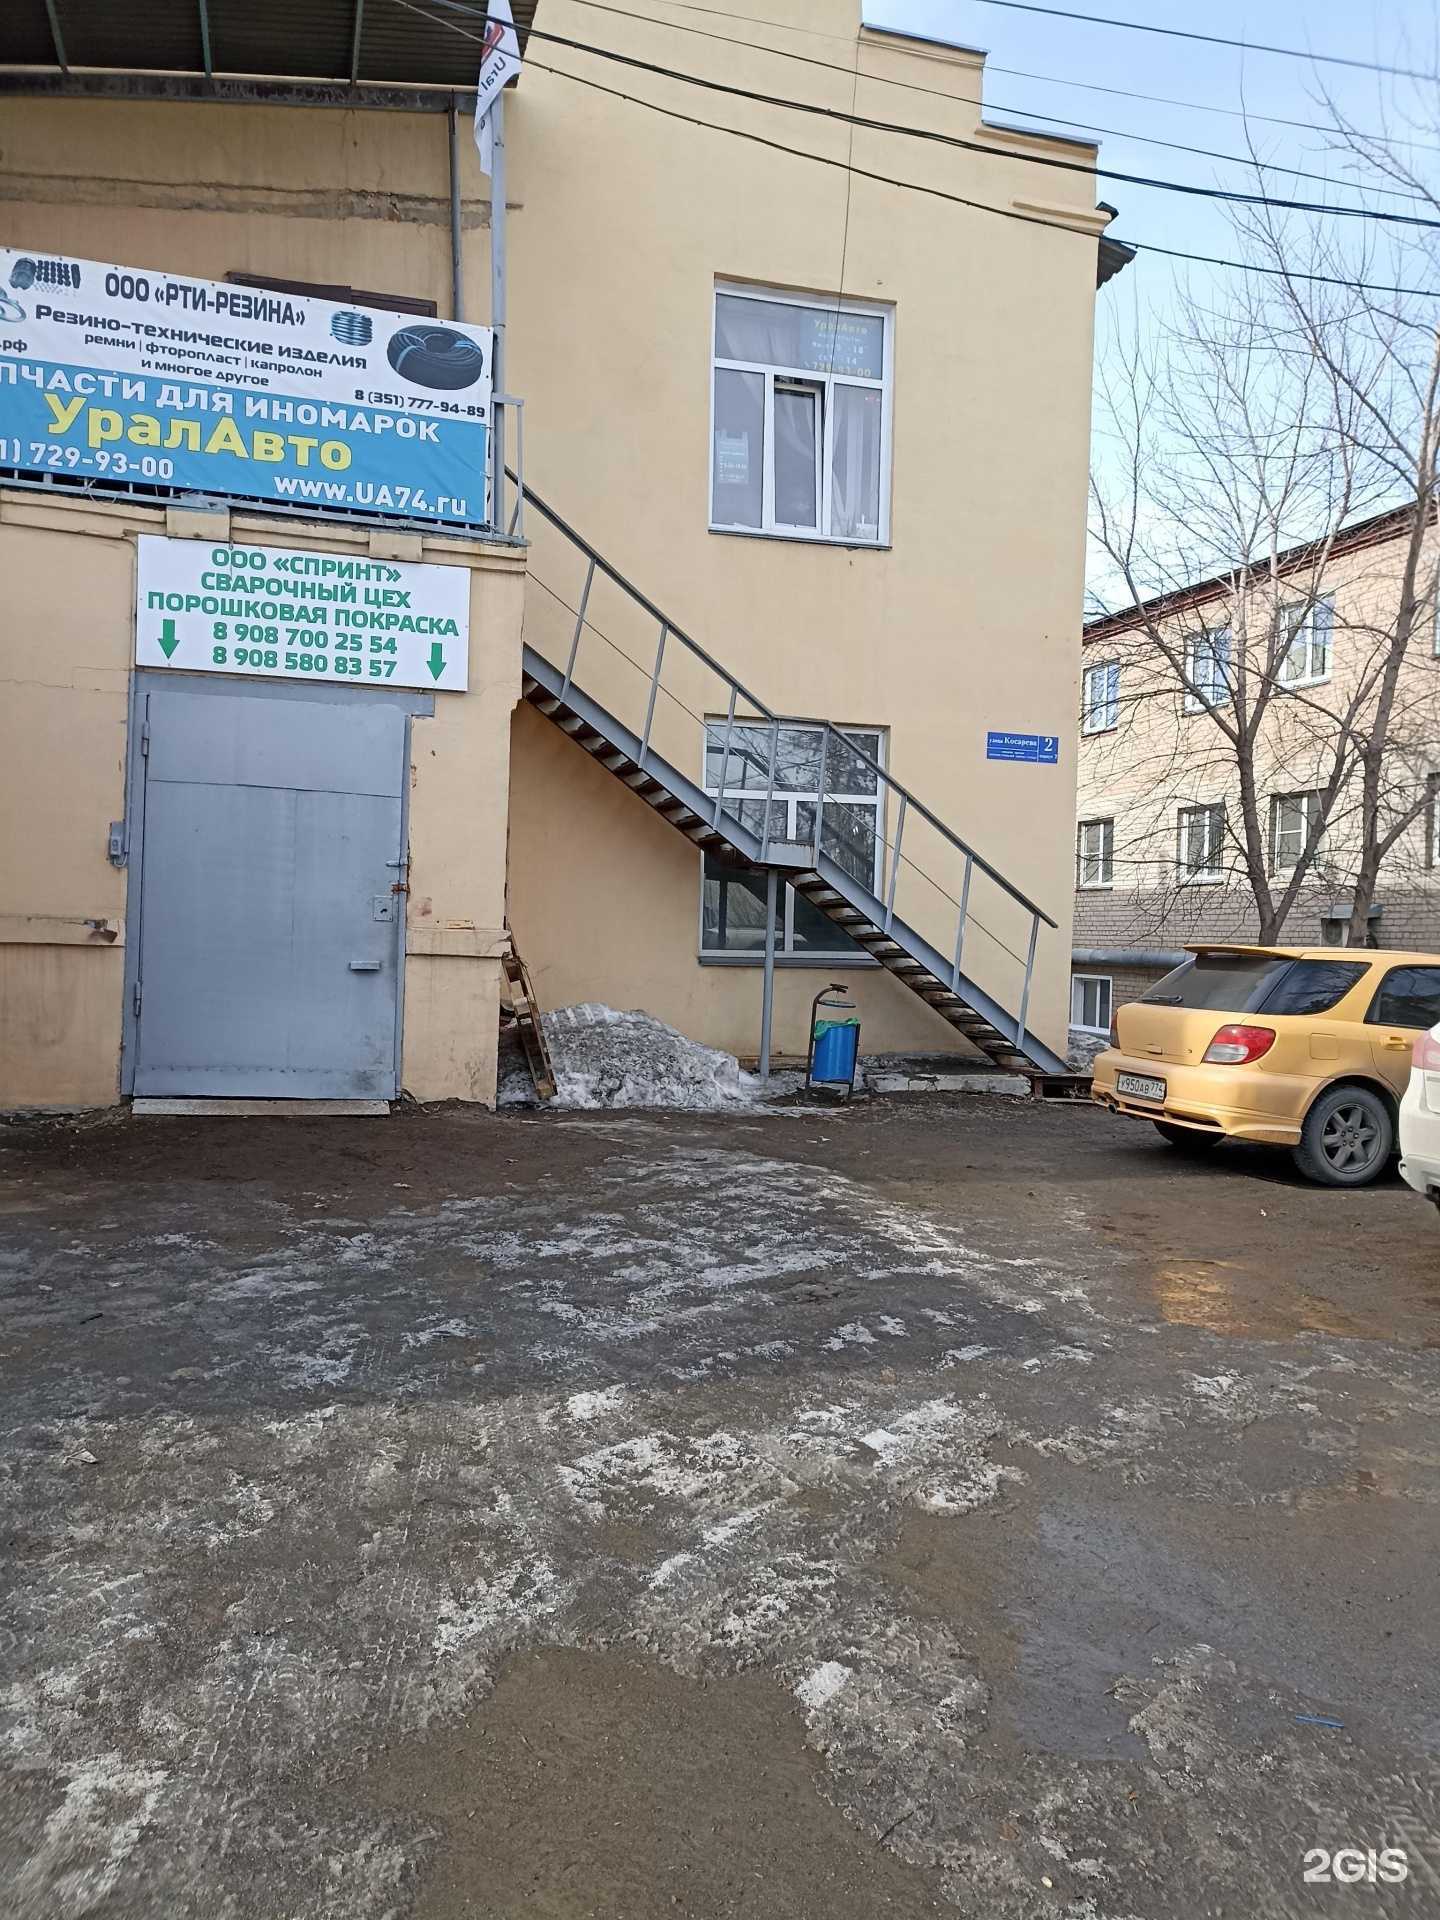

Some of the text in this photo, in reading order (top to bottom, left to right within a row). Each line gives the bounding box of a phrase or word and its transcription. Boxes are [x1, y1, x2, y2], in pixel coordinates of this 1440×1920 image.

[105, 272, 306, 326] ООО «РТИ-РЕЗИНА»
[35, 304, 367, 370] Резино-технические изделия
[84, 334, 323, 378] ремни фторопласт капролон
[141, 359, 270, 386] и многое другое
[155, 384, 234, 414] ДЛЯ
[245, 396, 441, 443] ИНОМАРОК
[354, 389, 485, 418] 8 (351) 777-94-89
[44, 392, 352, 471] УралАвто
[30, 442, 174, 480] 729-93-00
[274, 476, 466, 516] www.UA74.ru
[211, 548, 402, 583] ООО «СПРИНТ»
[201, 571, 411, 609] СВАРОЧНЫЙ ЦЕХ
[148, 592, 459, 636] ПОРОШКОВАЯ ПОКРАСКА
[213, 622, 398, 655] 8 908 700 25 54
[212, 646, 398, 678] 8 908 580 83 57
[1044, 738, 1053, 752] 2
